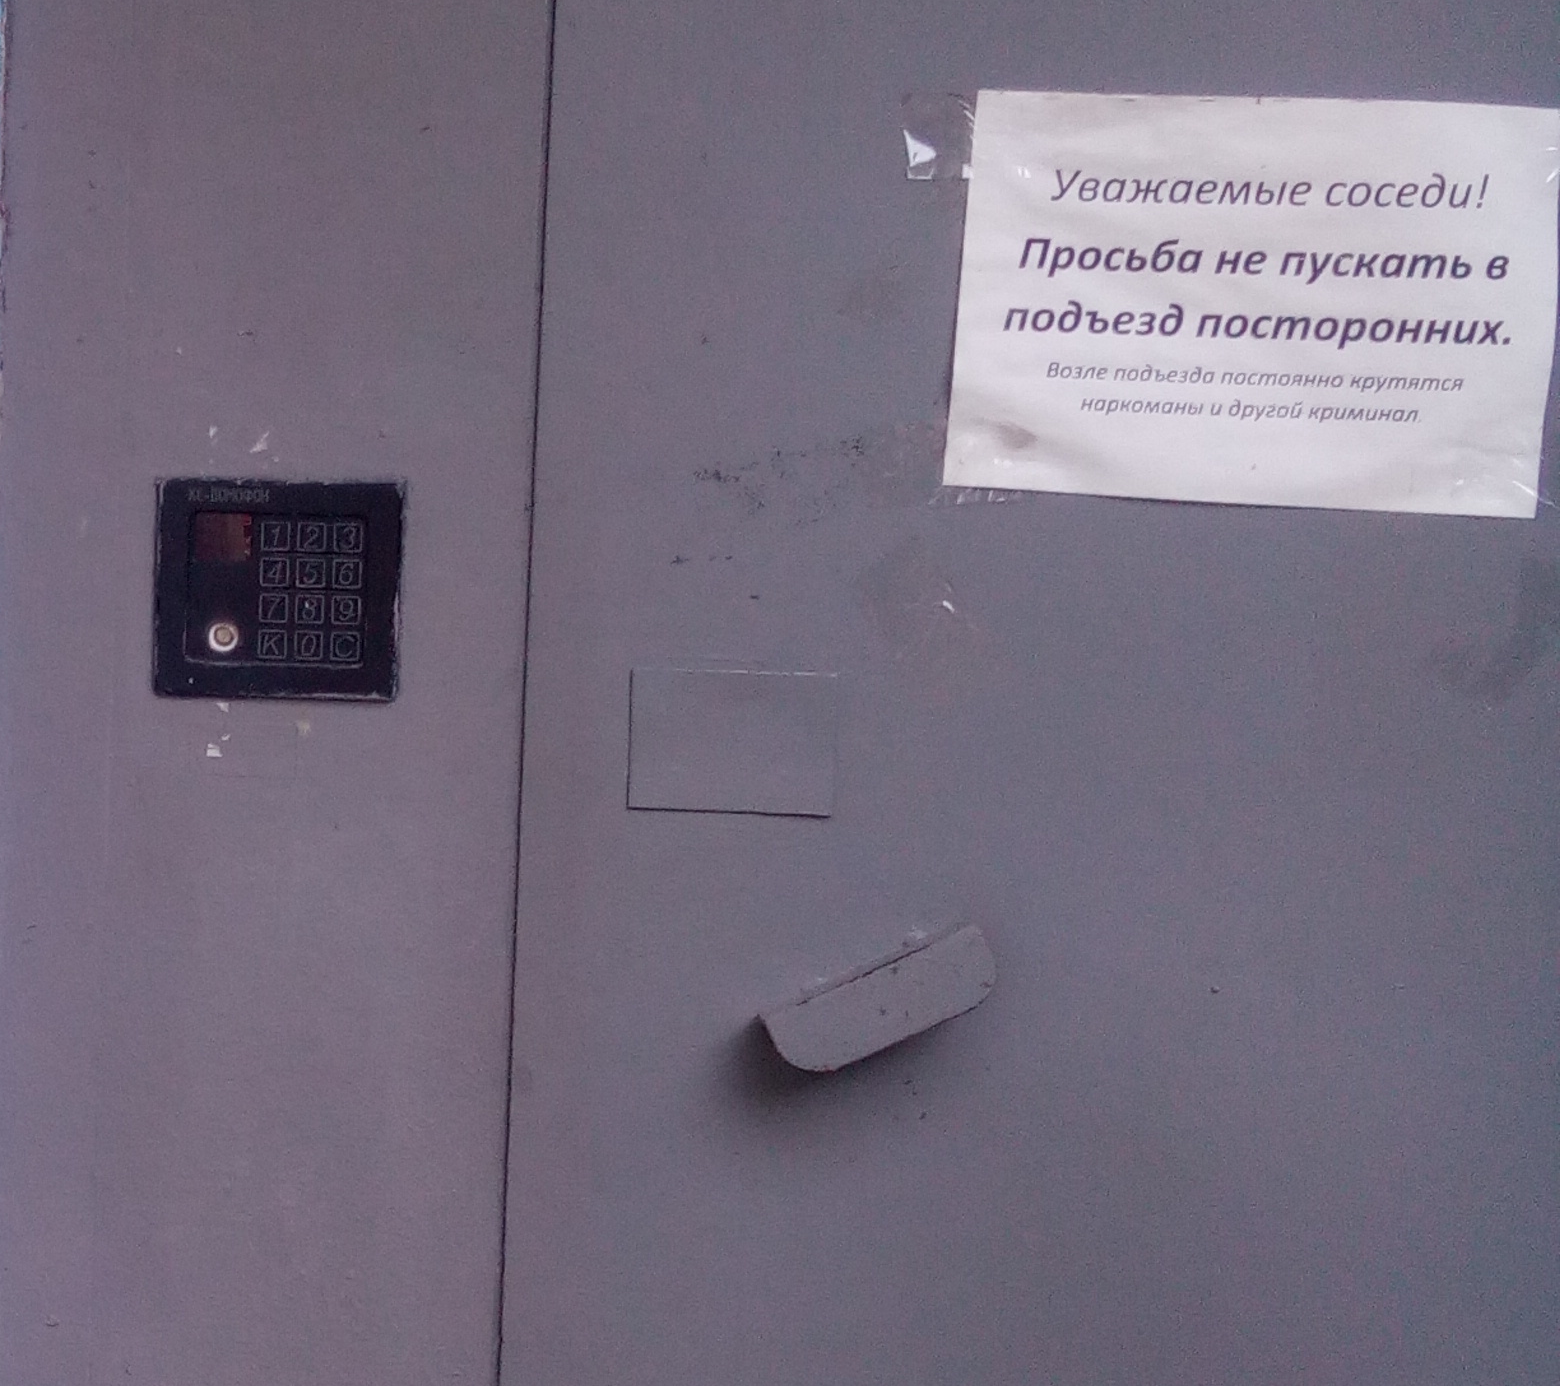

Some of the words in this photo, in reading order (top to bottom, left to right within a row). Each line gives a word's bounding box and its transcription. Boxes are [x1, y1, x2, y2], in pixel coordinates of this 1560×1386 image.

[1048, 167, 1313, 208] Уважаемые
[1324, 172, 1490, 211] соседи!
[1018, 237, 1201, 278] Просьба
[1213, 247, 1268, 276] не
[1278, 251, 1474, 286] пускать
[1484, 255, 1510, 280] в
[1002, 300, 1185, 339] подъезд
[1195, 311, 1513, 349] посторонних.
[1046, 361, 1109, 382] Возле
[1113, 364, 1216, 388] подъезда
[1220, 371, 1345, 393] постоянно
[1349, 374, 1464, 395] крутятся
[1079, 396, 1204, 417] наркоманы
[1209, 401, 1223, 417] и
[1228, 399, 1304, 424] другой
[1307, 404, 1423, 424] криминал.
[270, 526, 281, 548] 1
[306, 526, 320, 548] 2
[342, 526, 356, 548] 3
[267, 564, 283, 584] 4
[302, 564, 318, 585] 5
[340, 563, 354, 585] 6
[266, 598, 281, 619] 7
[301, 598, 316, 620] 8
[341, 598, 354, 620] 9
